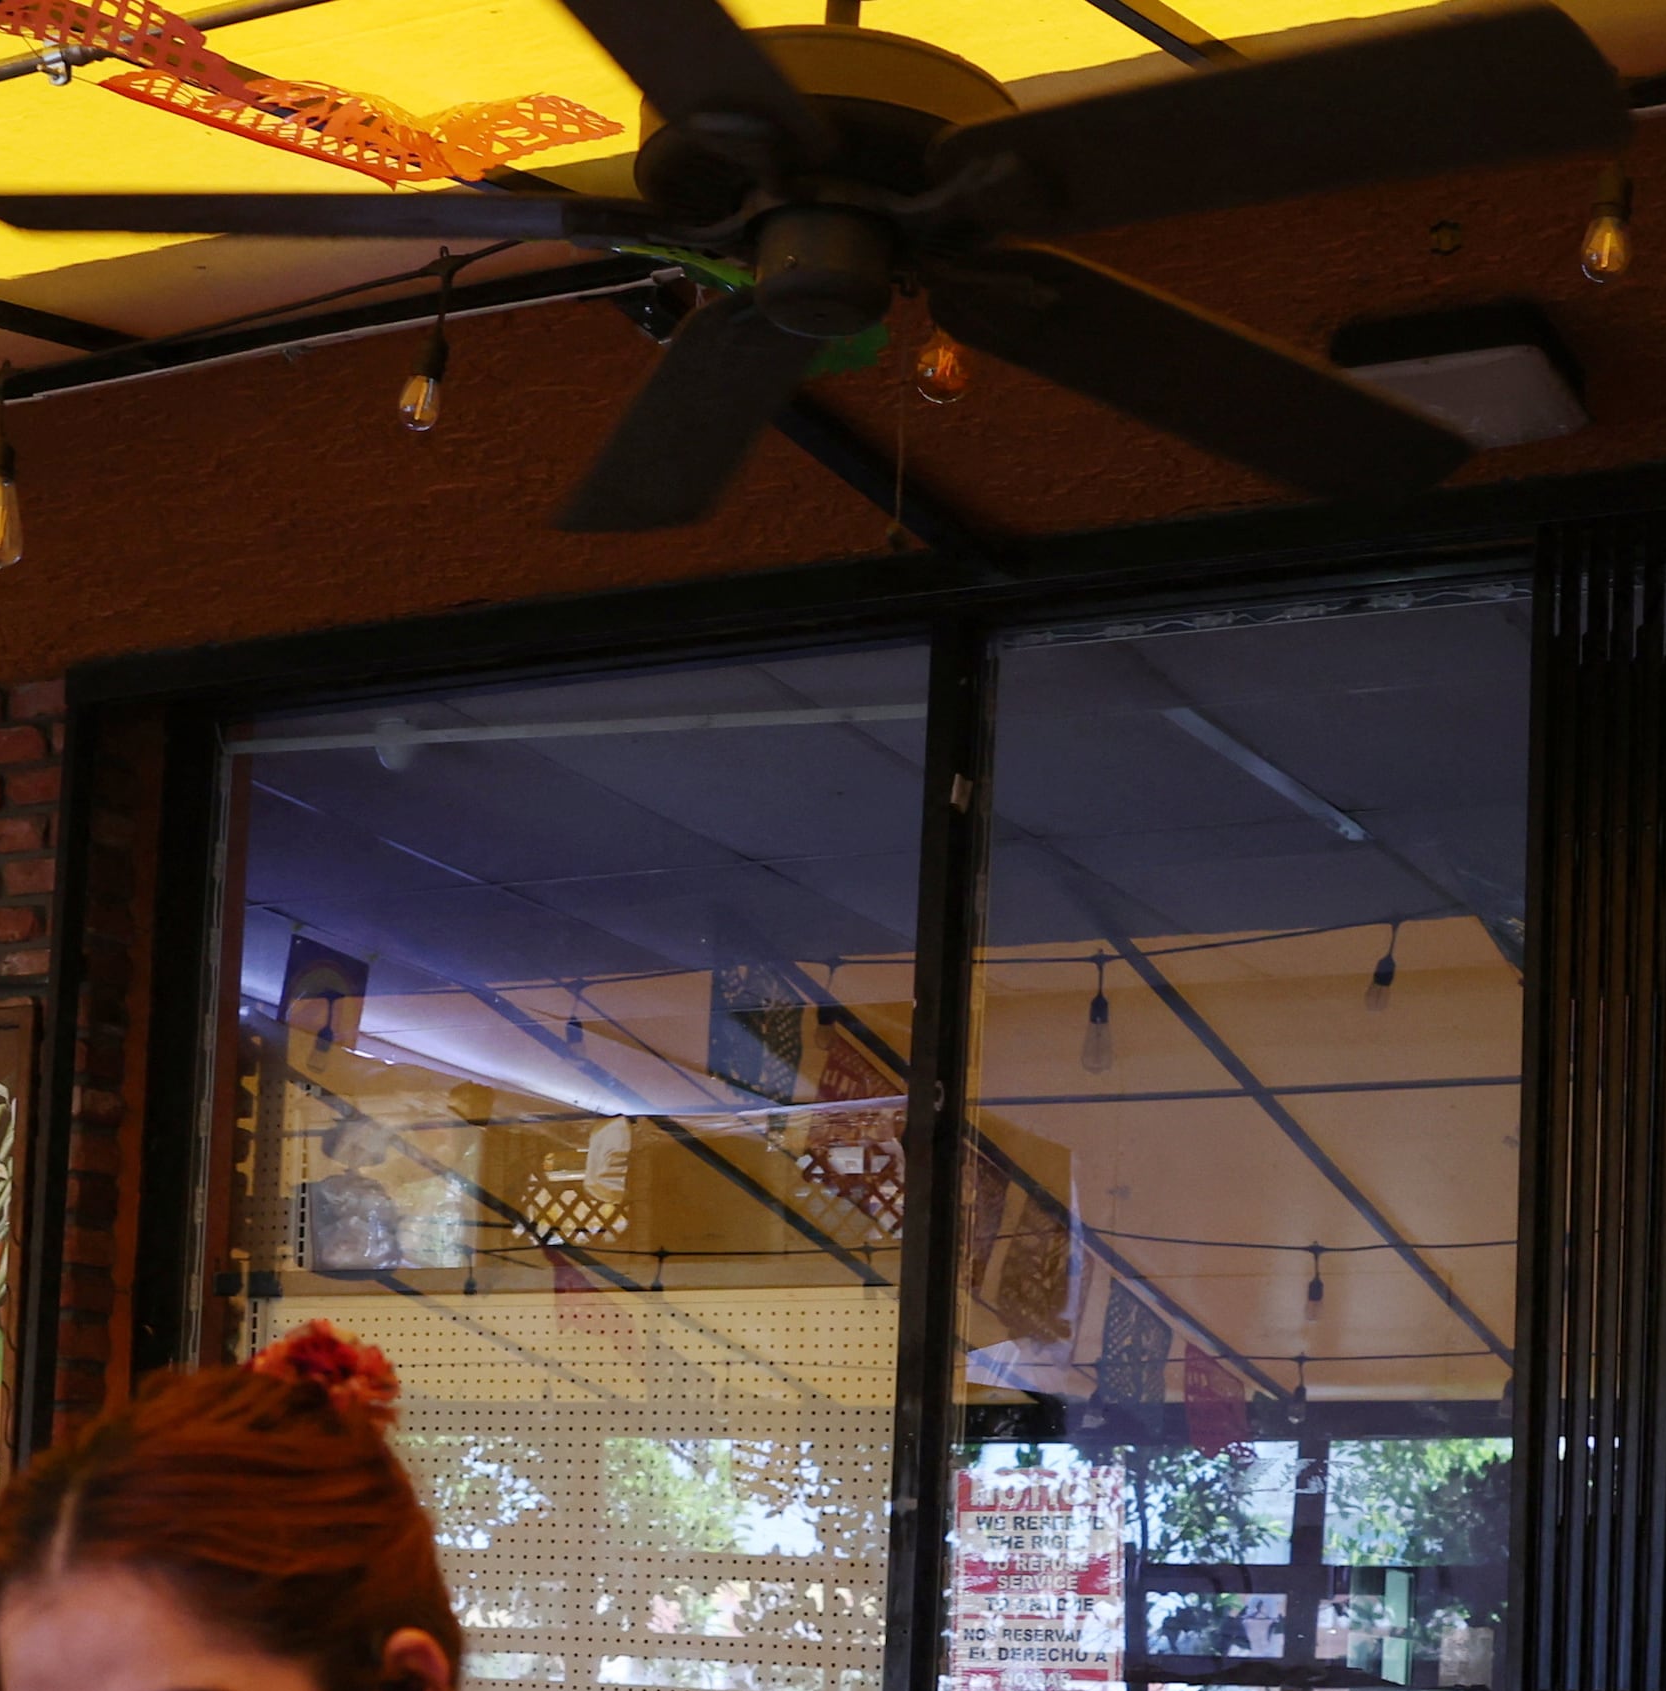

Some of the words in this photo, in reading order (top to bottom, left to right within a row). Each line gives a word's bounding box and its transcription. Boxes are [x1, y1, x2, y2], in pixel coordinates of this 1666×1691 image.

[976, 1515, 1006, 1531] WE
[1013, 1516, 1105, 1531] RESERE
[987, 1536, 1025, 1549] THE
[1031, 1536, 1087, 1550] RIG
[987, 1558, 1010, 1572] TO
[1015, 1557, 1089, 1572] REFUSE
[997, 1575, 1078, 1590] SERVICE
[985, 1598, 1009, 1612] TO
[1016, 1598, 1094, 1612] ANOE
[963, 1628, 997, 1642] NOS
[1002, 1629, 1087, 1643] RESERVA
[998, 1648, 1087, 1662] DERECHO
[1094, 1650, 1107, 1662] A
[1002, 1672, 1029, 1687] NO
[1032, 1672, 1072, 1687] DAR
